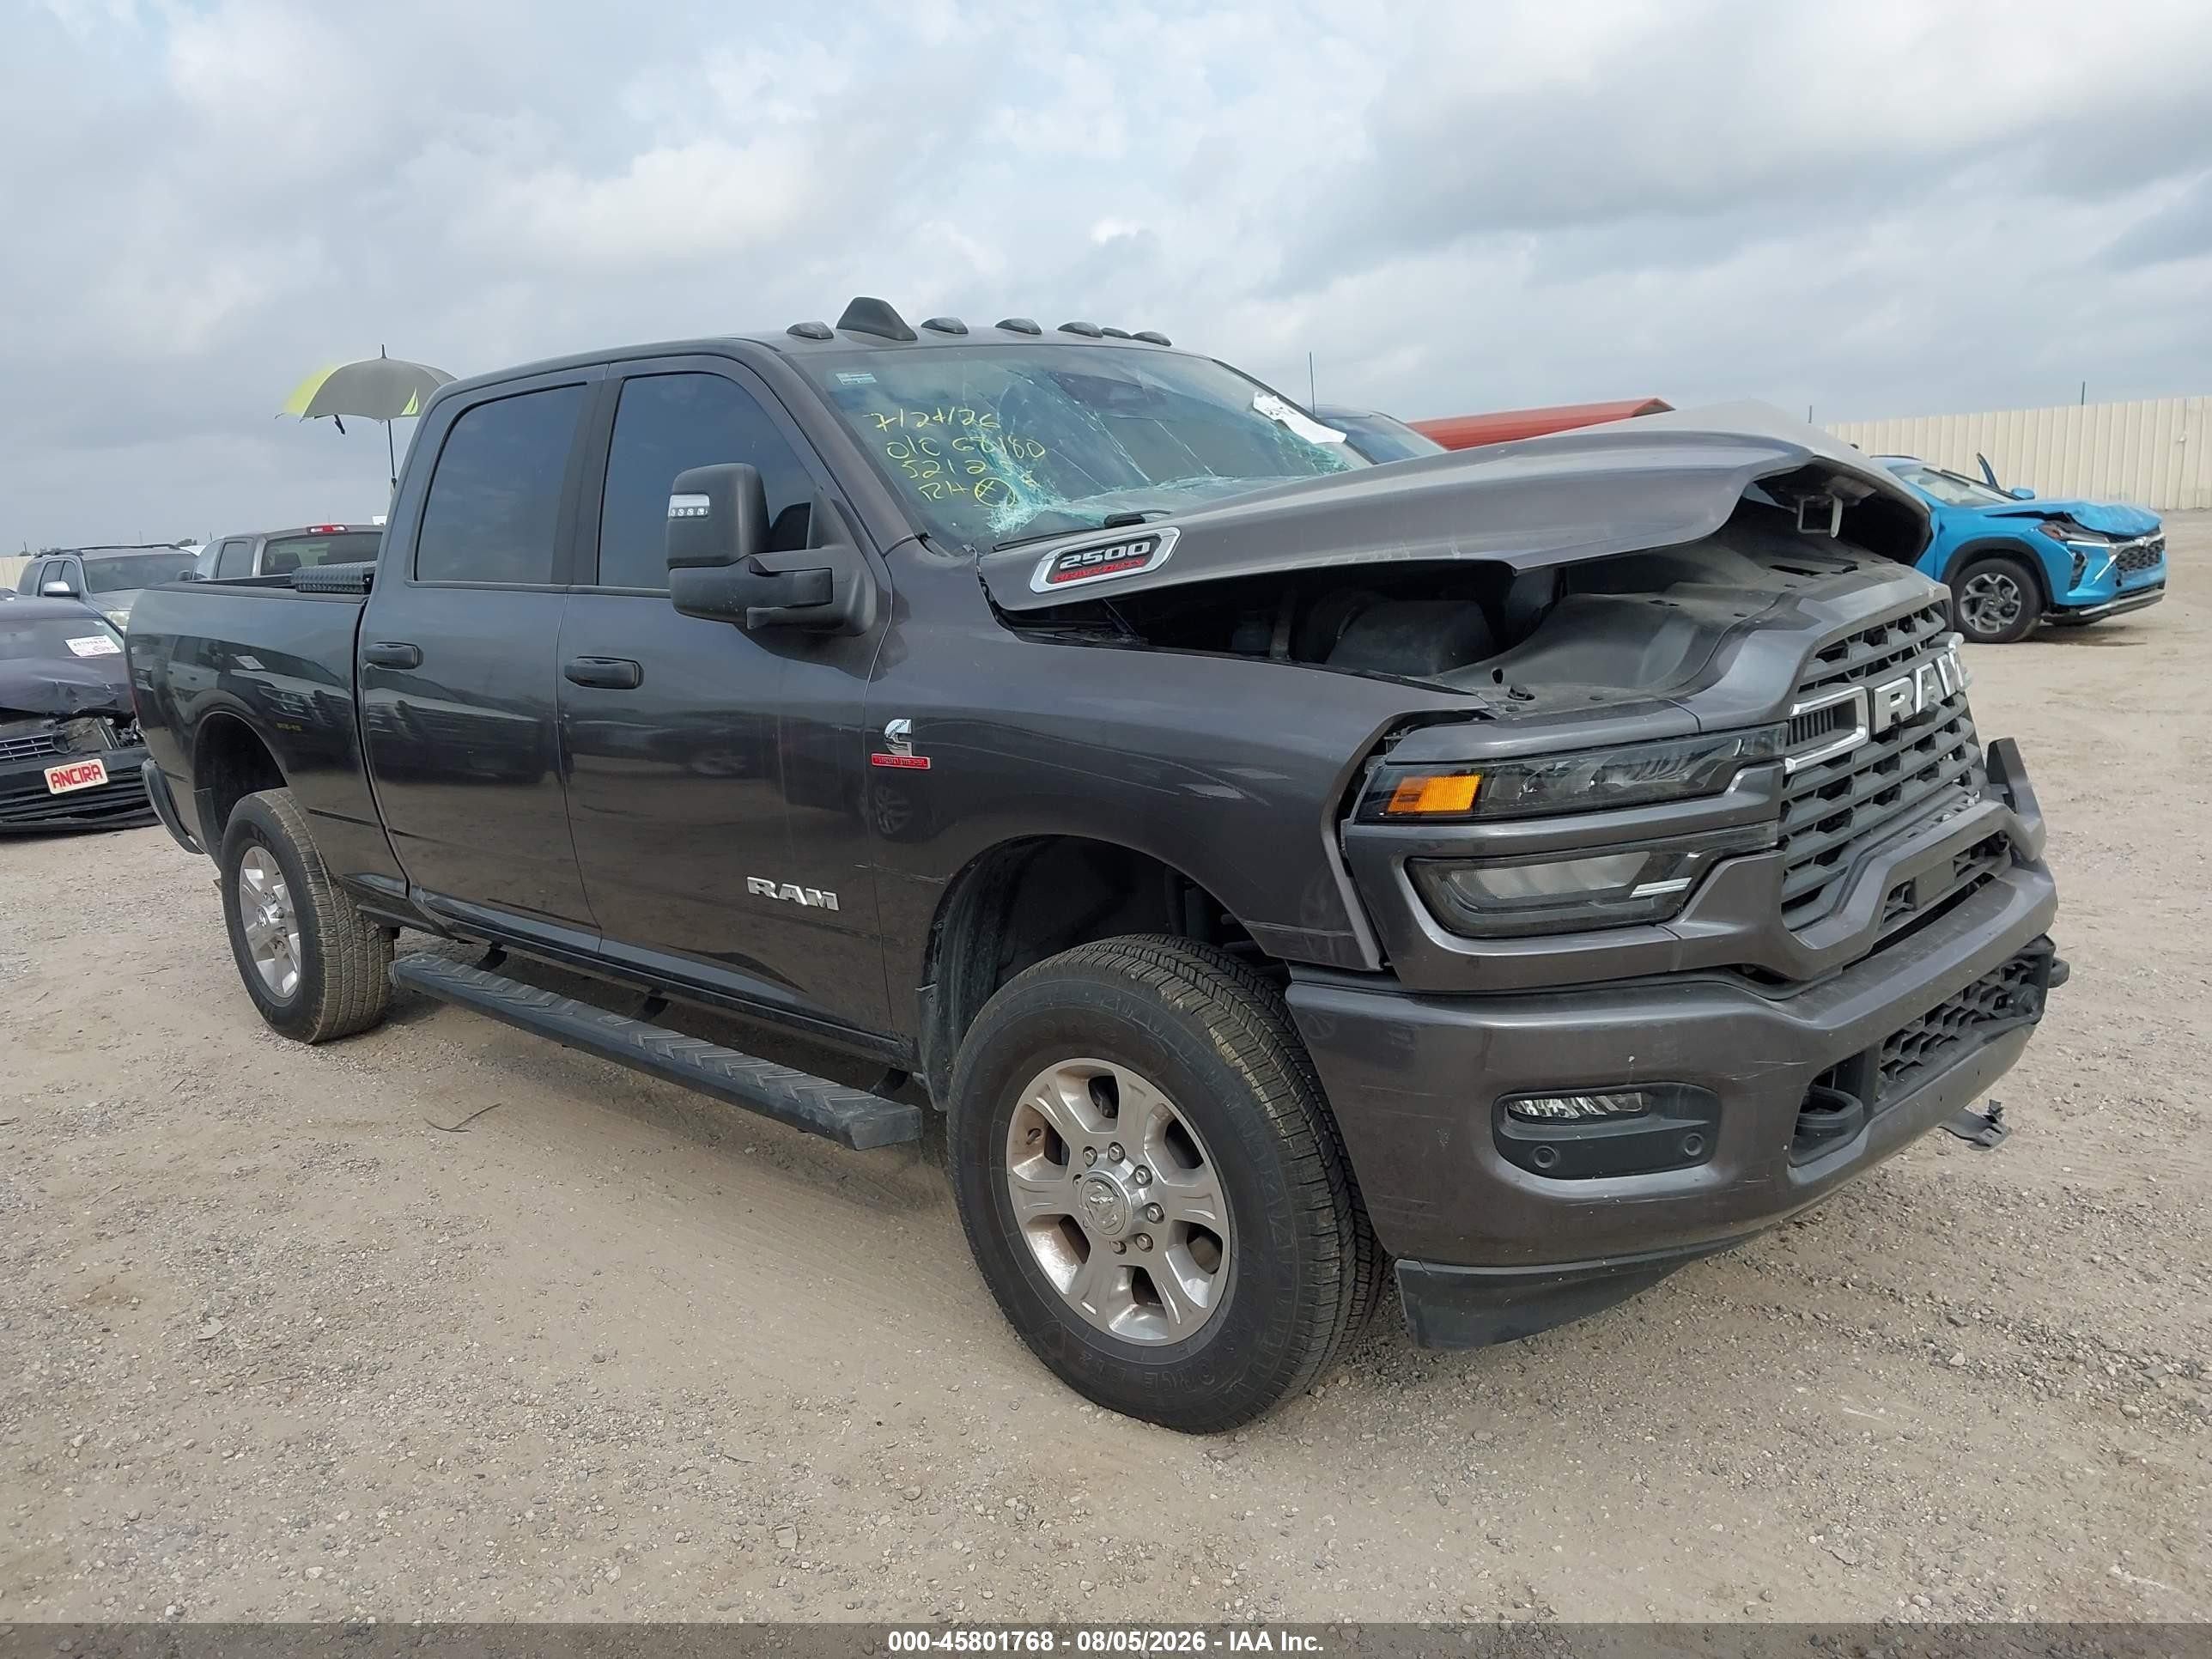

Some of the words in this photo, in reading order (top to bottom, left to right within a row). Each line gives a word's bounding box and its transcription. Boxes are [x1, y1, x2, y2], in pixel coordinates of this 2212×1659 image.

[1059, 541, 1151, 570] 2500
[51, 764, 103, 789] ANCIRA
[746, 876, 840, 911] RAM
